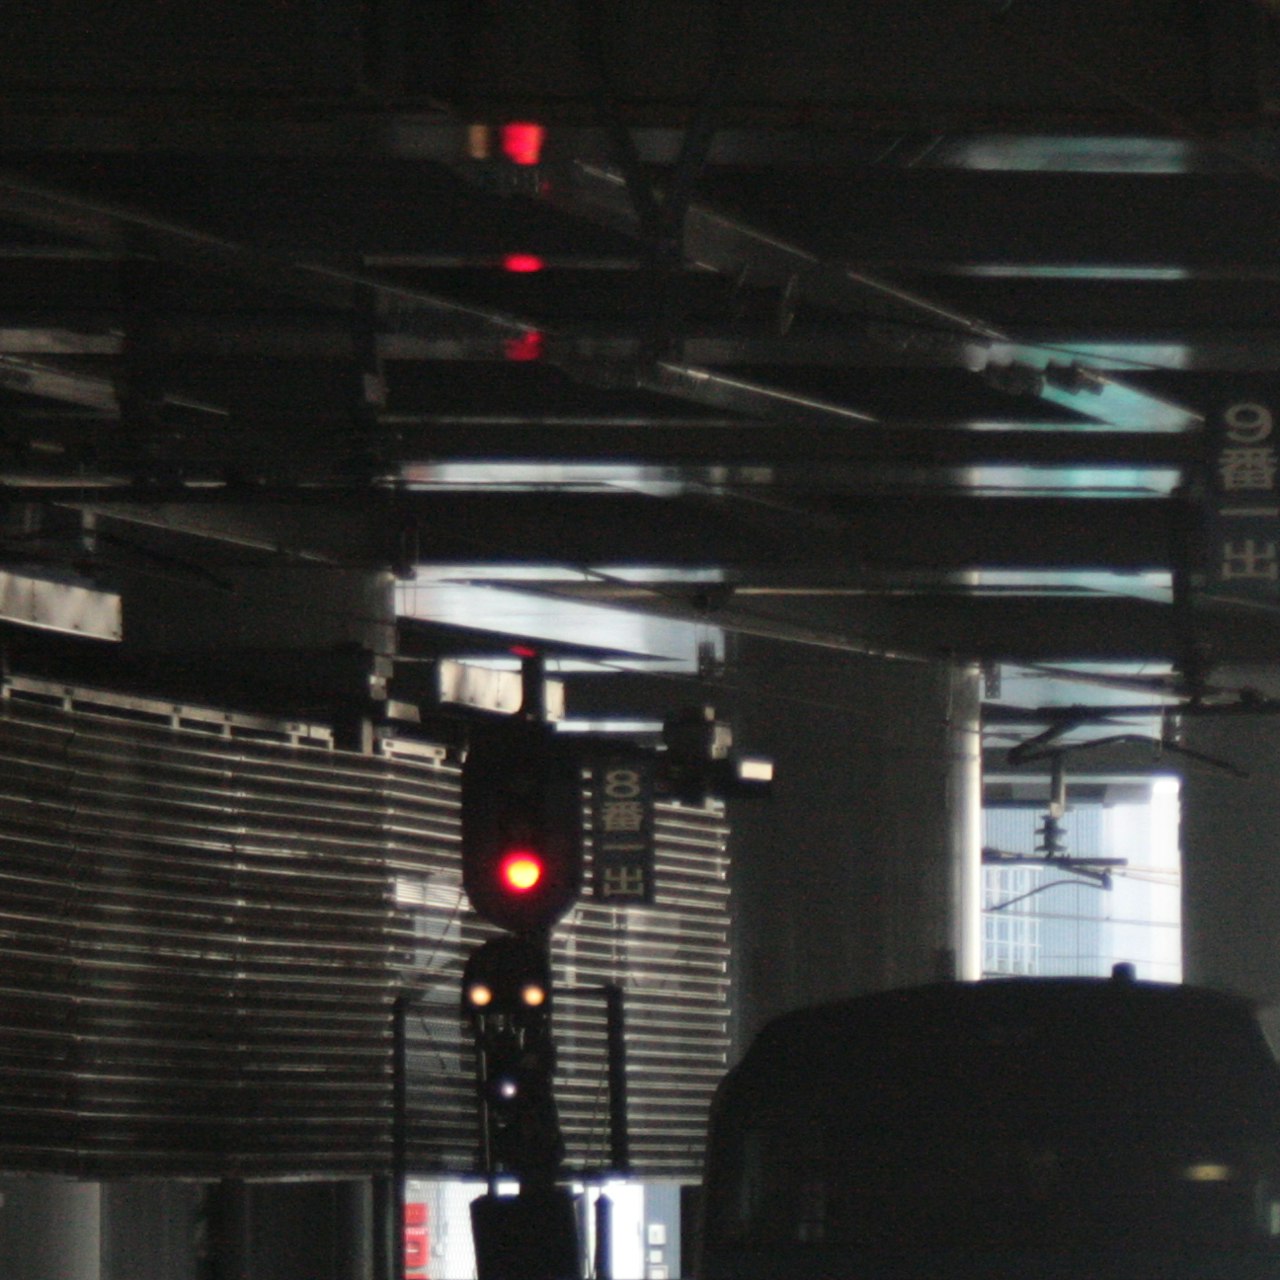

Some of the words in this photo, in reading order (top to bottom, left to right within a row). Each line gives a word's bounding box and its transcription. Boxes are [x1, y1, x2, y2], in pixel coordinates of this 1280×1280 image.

[1218, 402, 1279, 580] 9番一出
[601, 769, 646, 896] 8番一出
